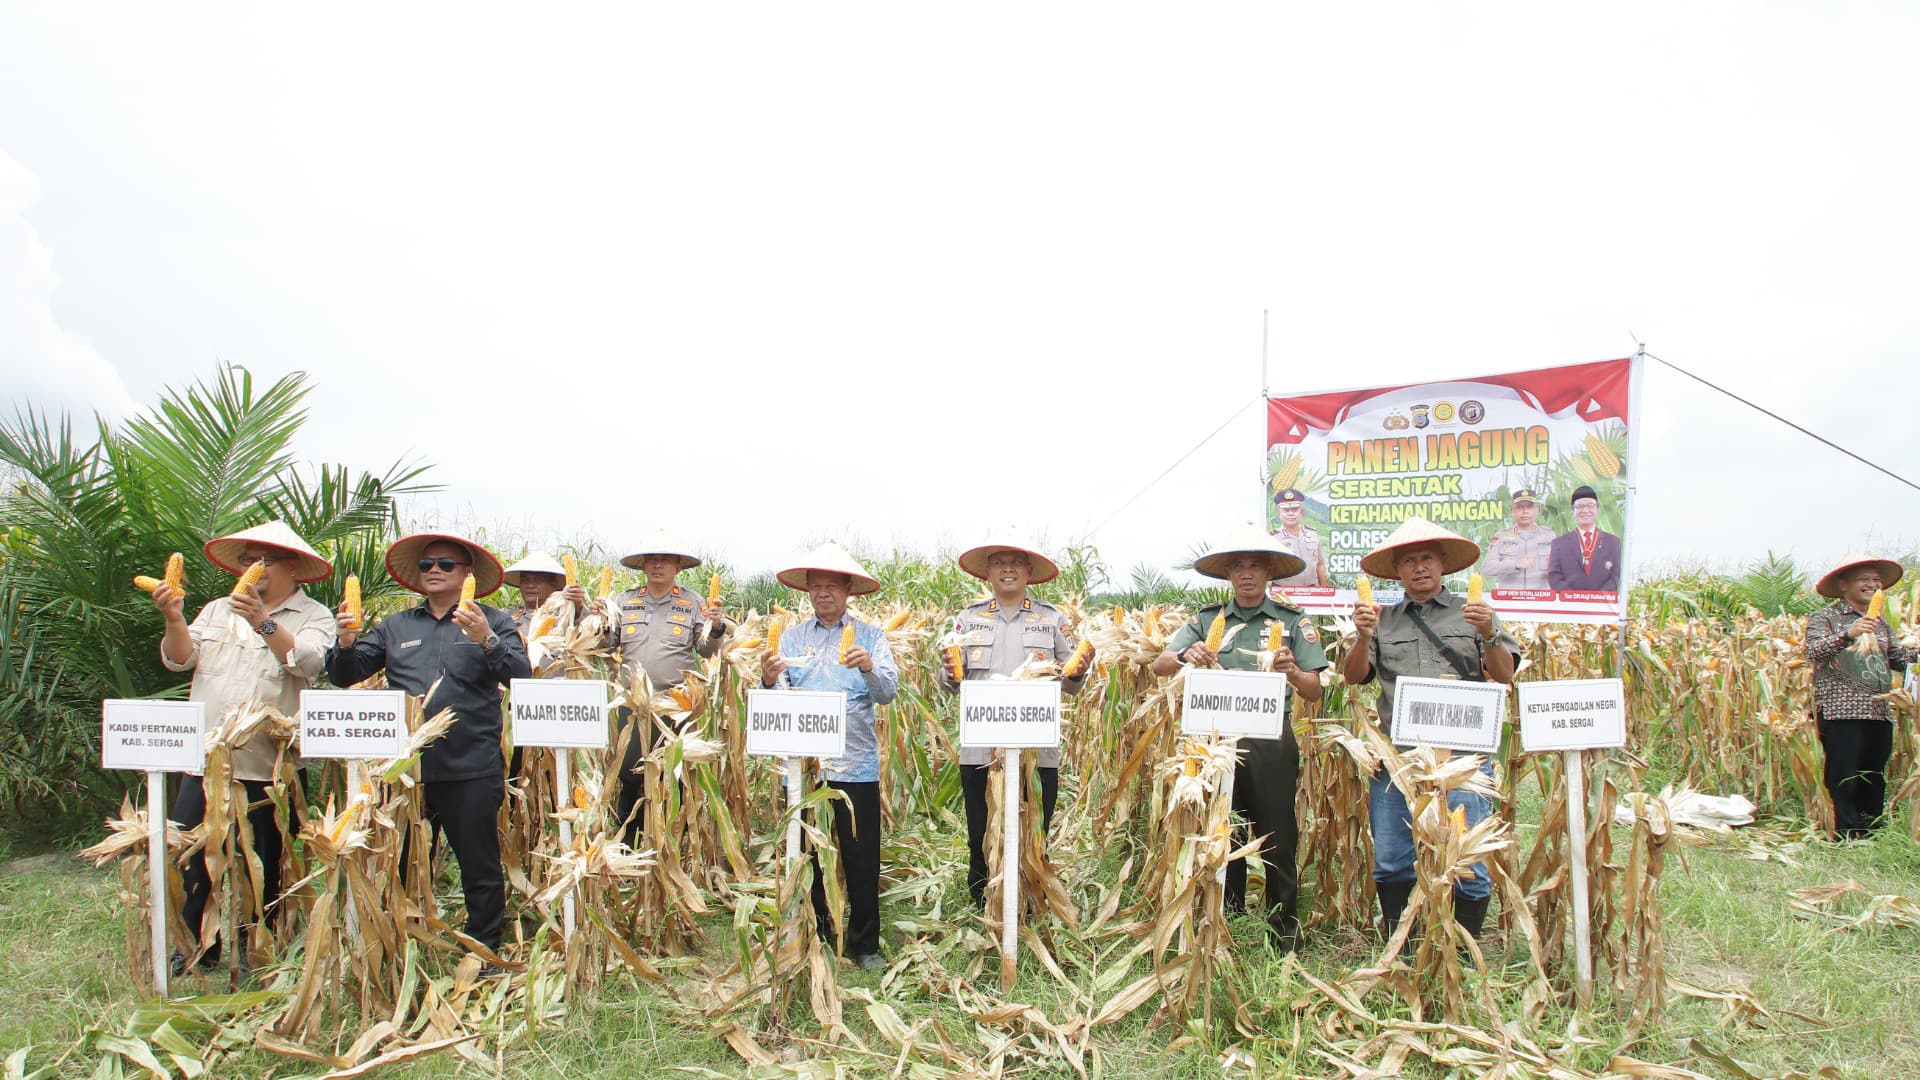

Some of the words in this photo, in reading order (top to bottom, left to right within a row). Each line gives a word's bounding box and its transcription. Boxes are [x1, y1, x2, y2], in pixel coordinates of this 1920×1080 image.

[1328, 437, 1419, 475] PANEN
[1425, 426, 1550, 471] JAGUNG
[1329, 474, 1462, 498] SERENTAK
[1330, 502, 1428, 524] KETAHANAN
[1431, 500, 1503, 522] PANGAN
[1330, 530, 1389, 550] POLRES
[1329, 554, 1361, 574] SERD
[671, 606, 692, 614] POLRI
[1190, 693, 1232, 712] DANDIM
[1235, 695, 1260, 713] 0204
[1262, 697, 1277, 714] DS
[1527, 703, 1550, 714] KETUA
[1551, 701, 1595, 712] PENGADILAN
[1595, 699, 1617, 710] NEGRI
[307, 711, 354, 721] KETUA
[358, 711, 396, 721] DPRD
[517, 704, 557, 722] KAJARI
[560, 705, 601, 722] SERGAI
[966, 706, 1017, 723] KAPOLRES
[1019, 706, 1055, 723] SERGAI
[109, 723, 138, 734] KADIS
[141, 724, 197, 735] PERTANIAN
[752, 712, 792, 733] BUPATI
[798, 713, 839, 735] SERGAI
[1551, 718, 1568, 729] KAB.
[1569, 717, 1594, 729] SERGAI
[307, 727, 341, 738] KAB.
[345, 728, 396, 738] SERGAI
[121, 737, 145, 747] KAB.
[147, 738, 184, 748] SERGAI
